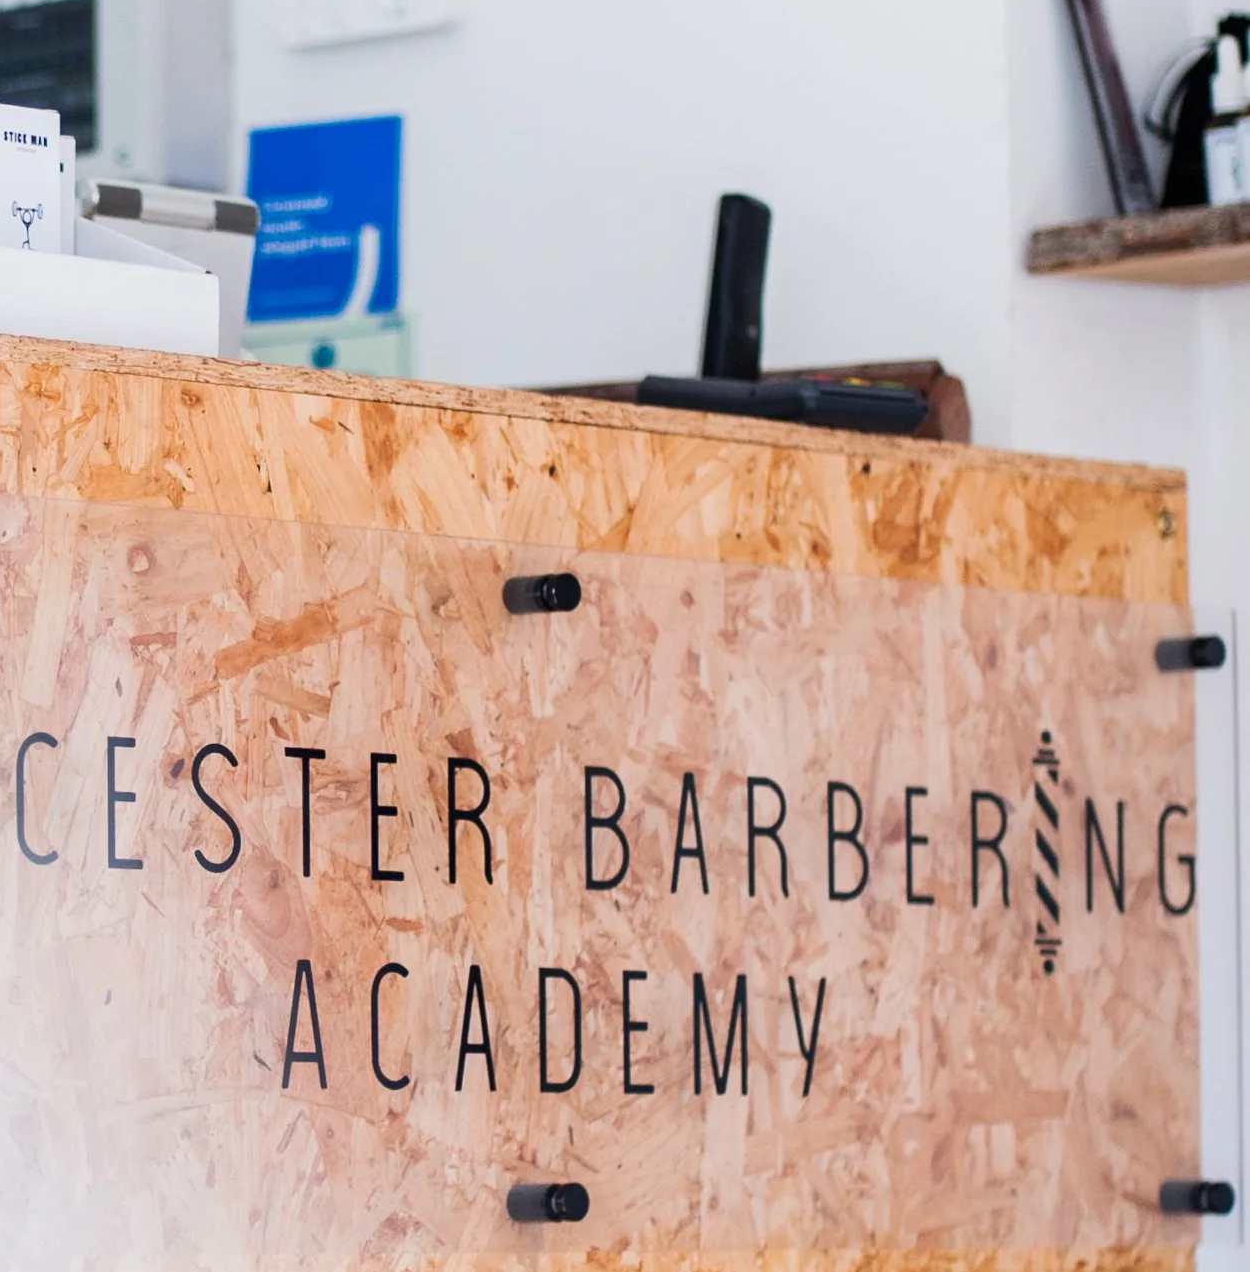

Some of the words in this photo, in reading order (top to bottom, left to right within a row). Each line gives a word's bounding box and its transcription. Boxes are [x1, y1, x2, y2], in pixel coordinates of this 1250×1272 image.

[3, 130, 28, 145] STICK
[30, 134, 48, 148] MAN
[583, 730, 1197, 975] BARBERING
[281, 958, 827, 1098] ACADEMY
